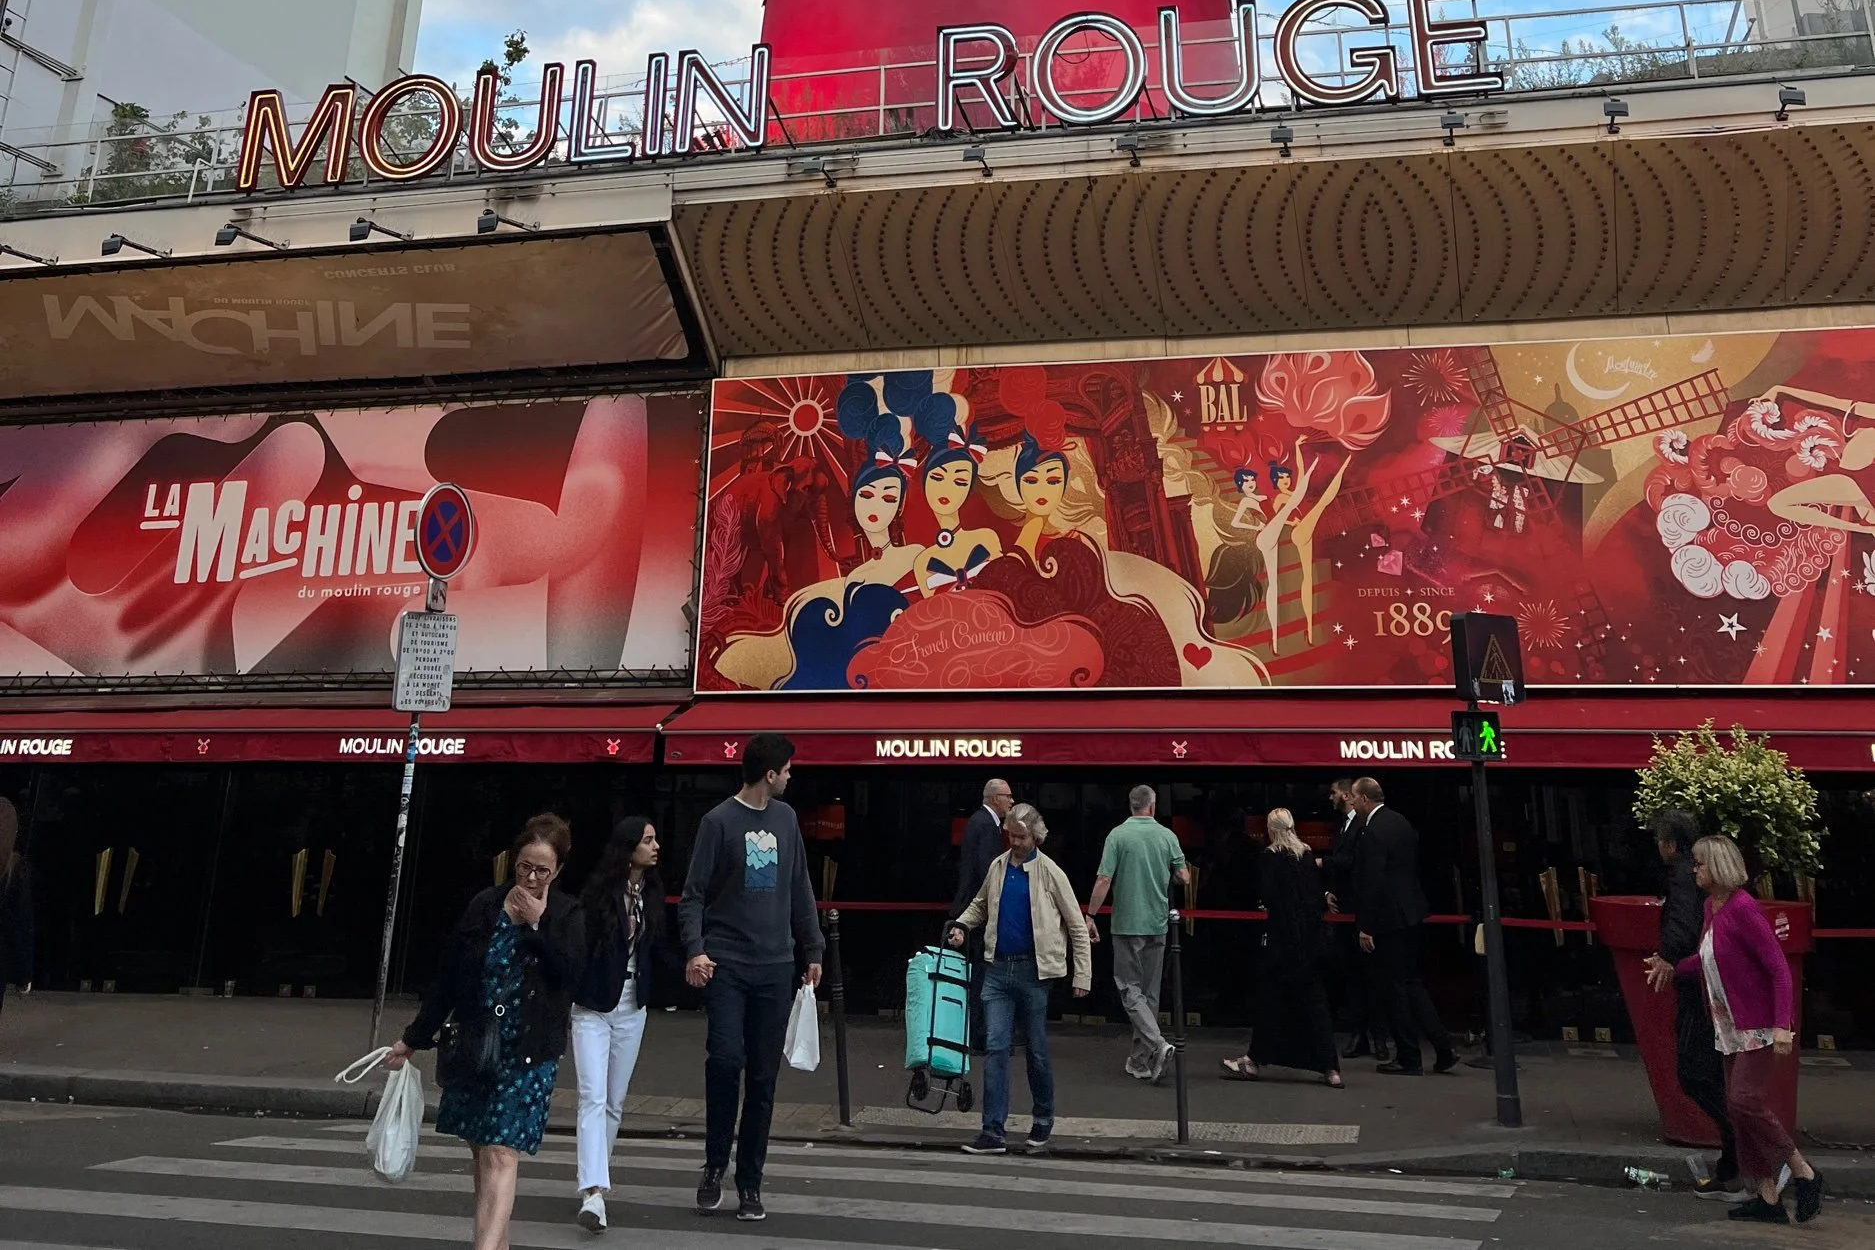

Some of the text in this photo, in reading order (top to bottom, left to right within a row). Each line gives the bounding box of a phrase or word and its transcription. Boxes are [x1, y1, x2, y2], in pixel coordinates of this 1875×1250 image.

[235, 42, 772, 193] MOULIN
[1199, 384, 1248, 424] BAL
[144, 483, 181, 517] LA
[297, 585, 421, 598] du moulin rouge
[1358, 586, 1455, 597] DEPUIS SINCE
[1373, 602, 1453, 645] 1889
[889, 621, 1015, 668] French Cancan
[18, 738, 73, 755] ROUGE
[339, 738, 404, 754] MOULIN
[876, 739, 1023, 758] MOULIN ROUGE
[1340, 740, 1424, 759] MOULIN
